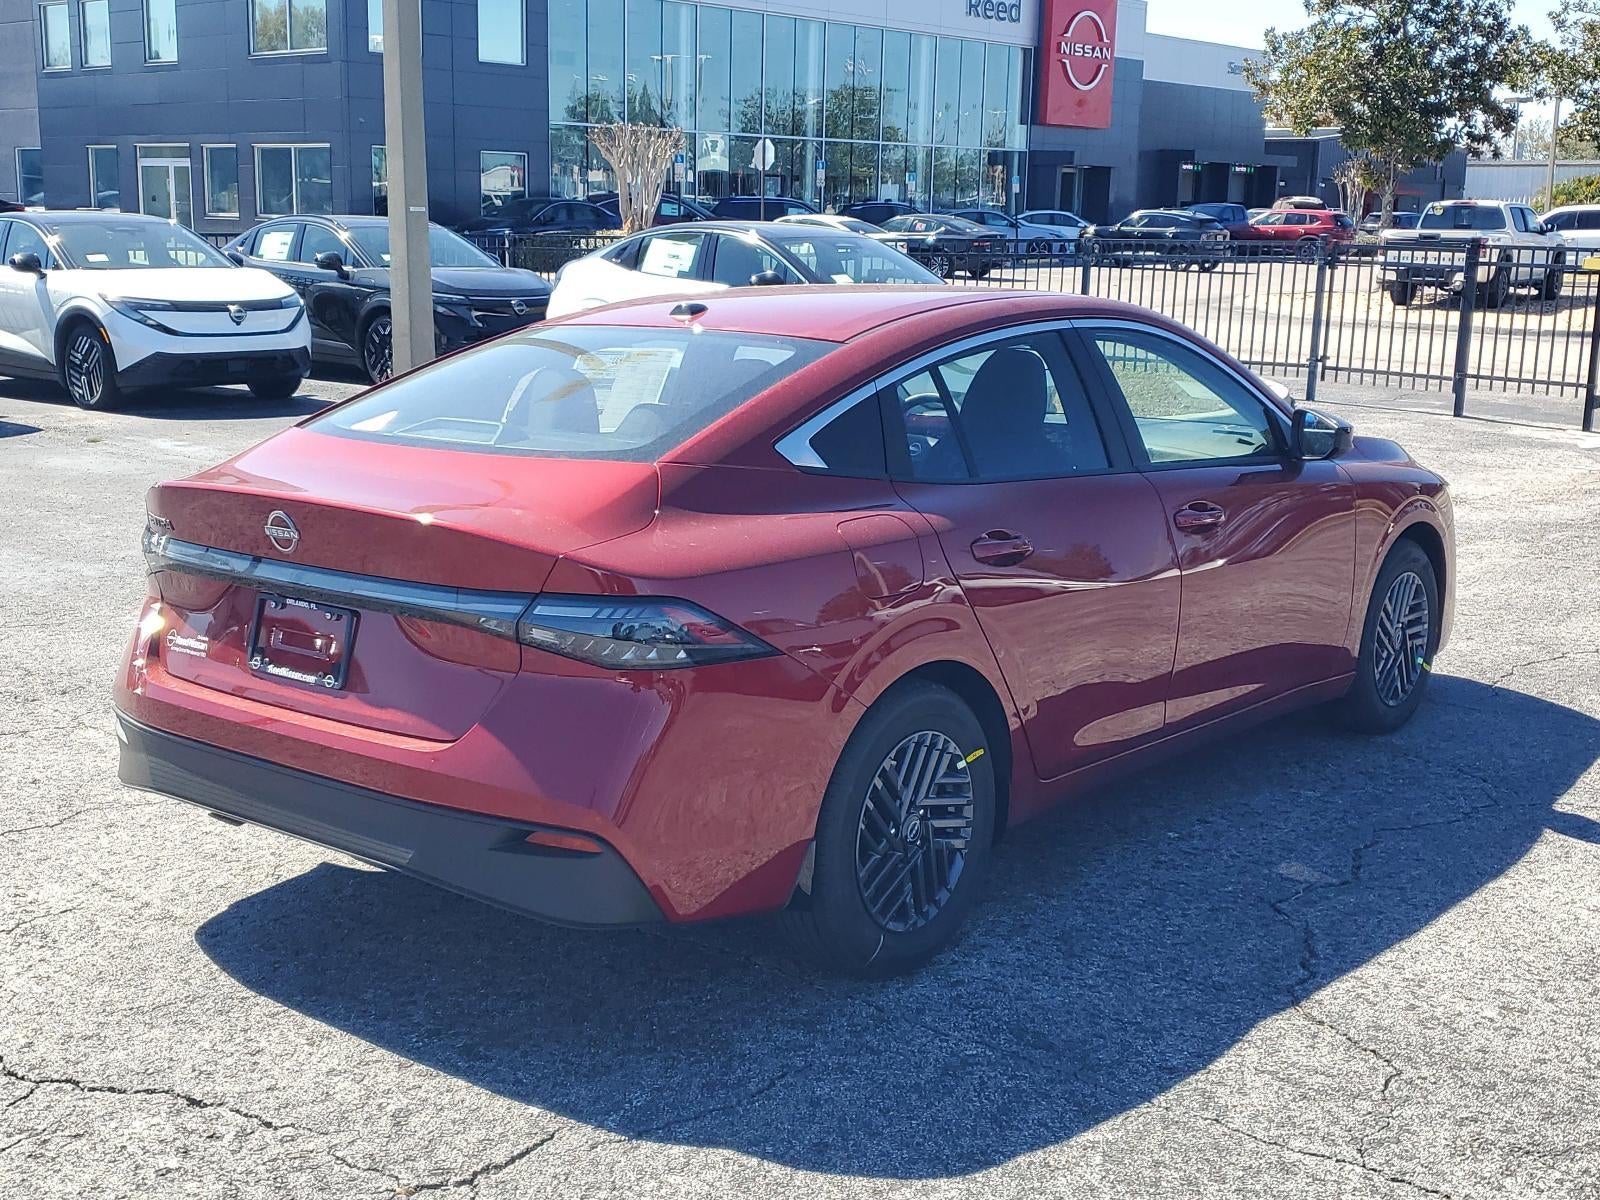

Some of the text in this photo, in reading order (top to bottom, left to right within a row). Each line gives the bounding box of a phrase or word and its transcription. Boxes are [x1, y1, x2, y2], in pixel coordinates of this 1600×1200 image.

[967, 0, 1021, 23] Reed
[1060, 41, 1111, 60] NISSAN
[265, 526, 299, 539] NISSAN
